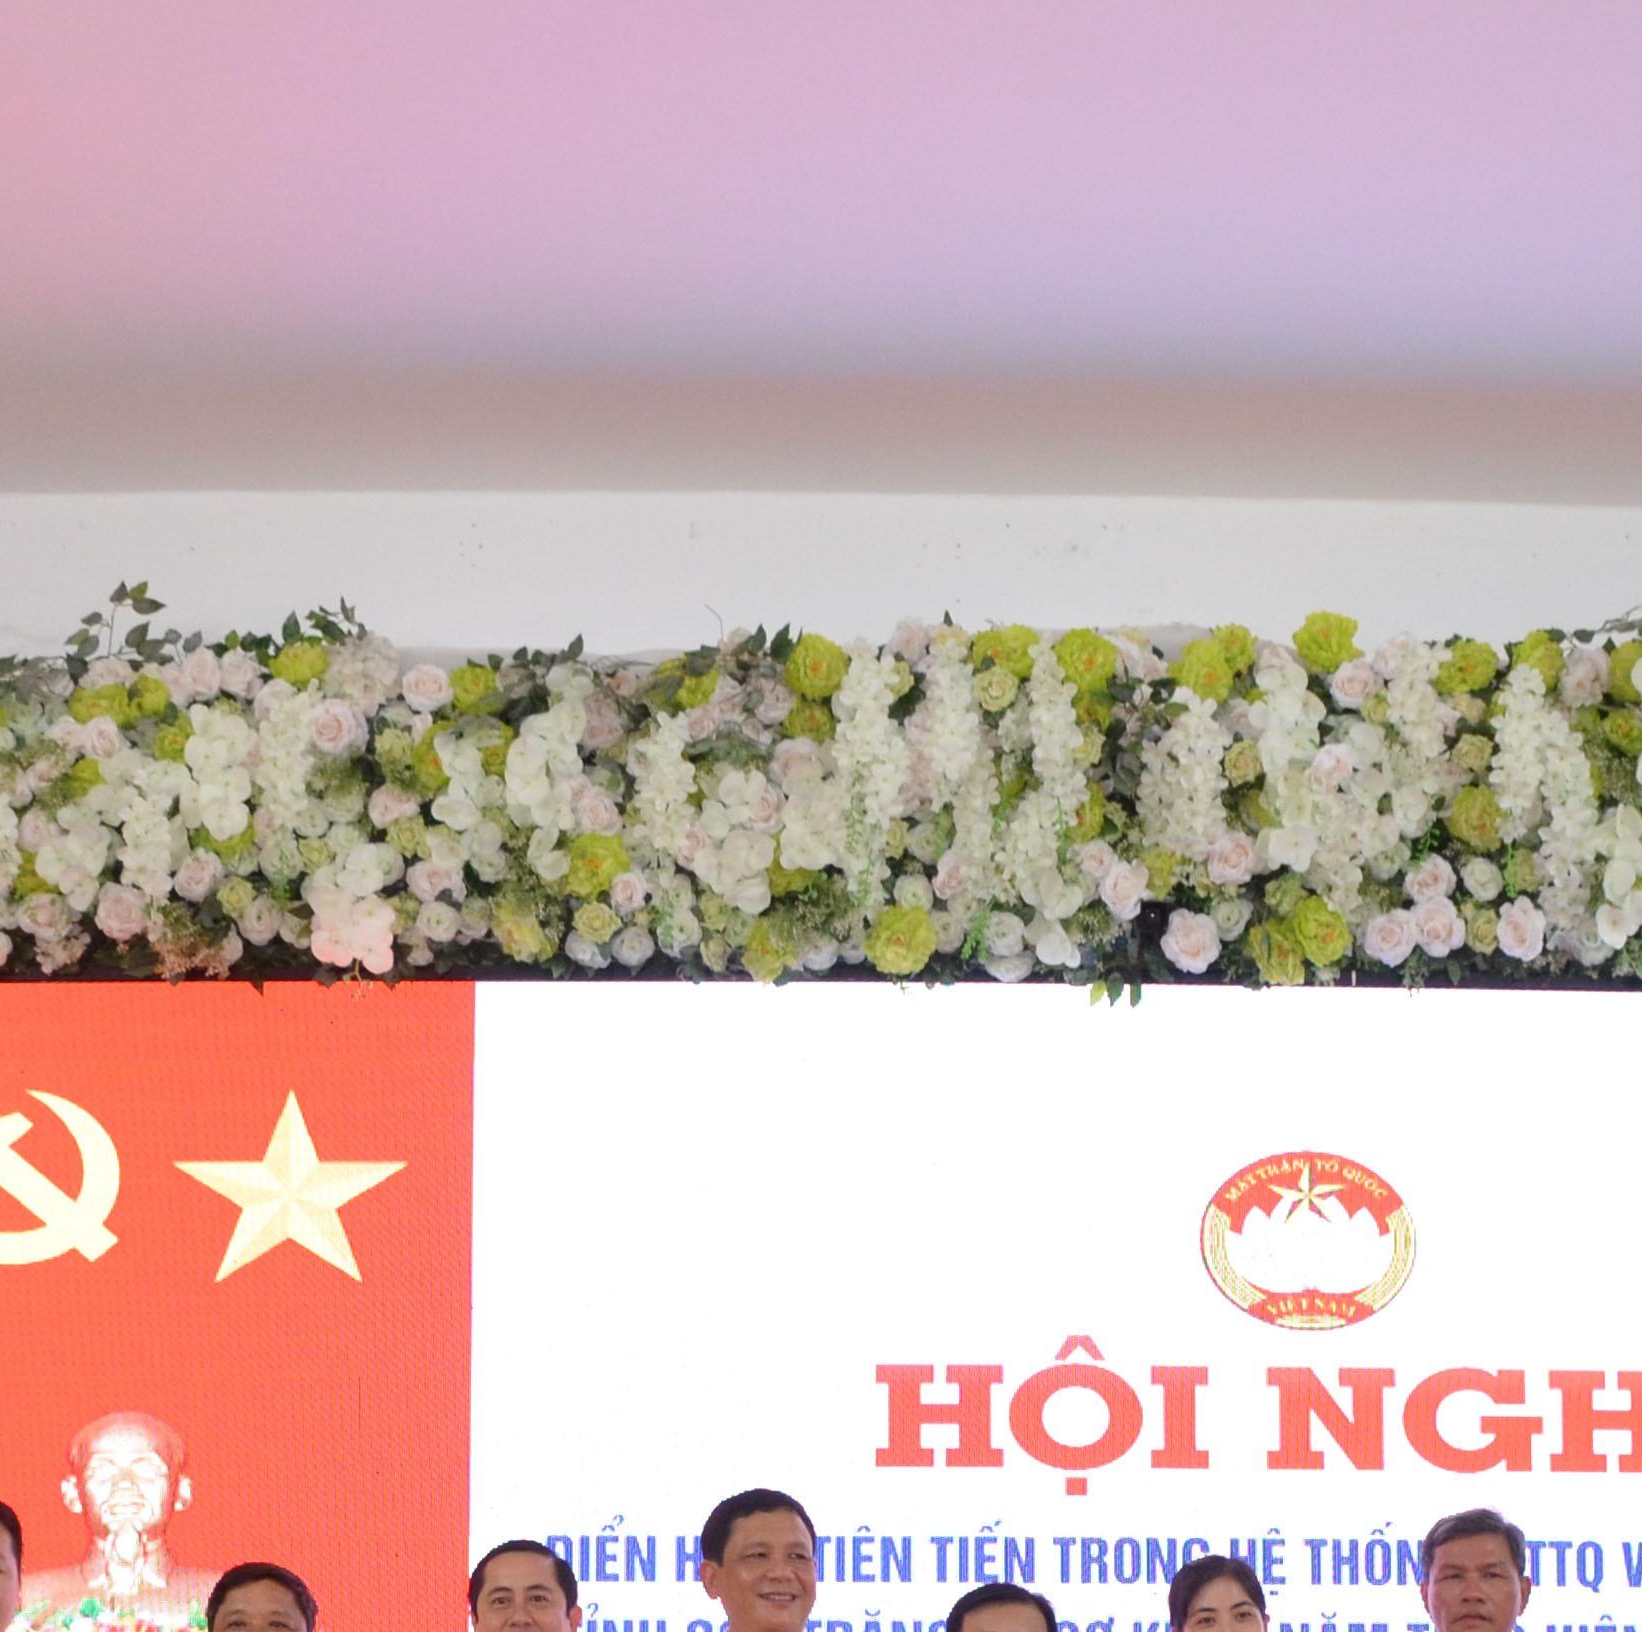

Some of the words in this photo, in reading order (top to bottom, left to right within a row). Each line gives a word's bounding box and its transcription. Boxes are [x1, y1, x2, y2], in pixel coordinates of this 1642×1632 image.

[876, 1335, 1210, 1496] HỘI
[815, 1525, 912, 1583] TIÊN
[930, 1520, 1036, 1585] TIẾN
[1307, 1521, 1425, 1586] THỐN
[1524, 1540, 1604, 1593] TTQ
